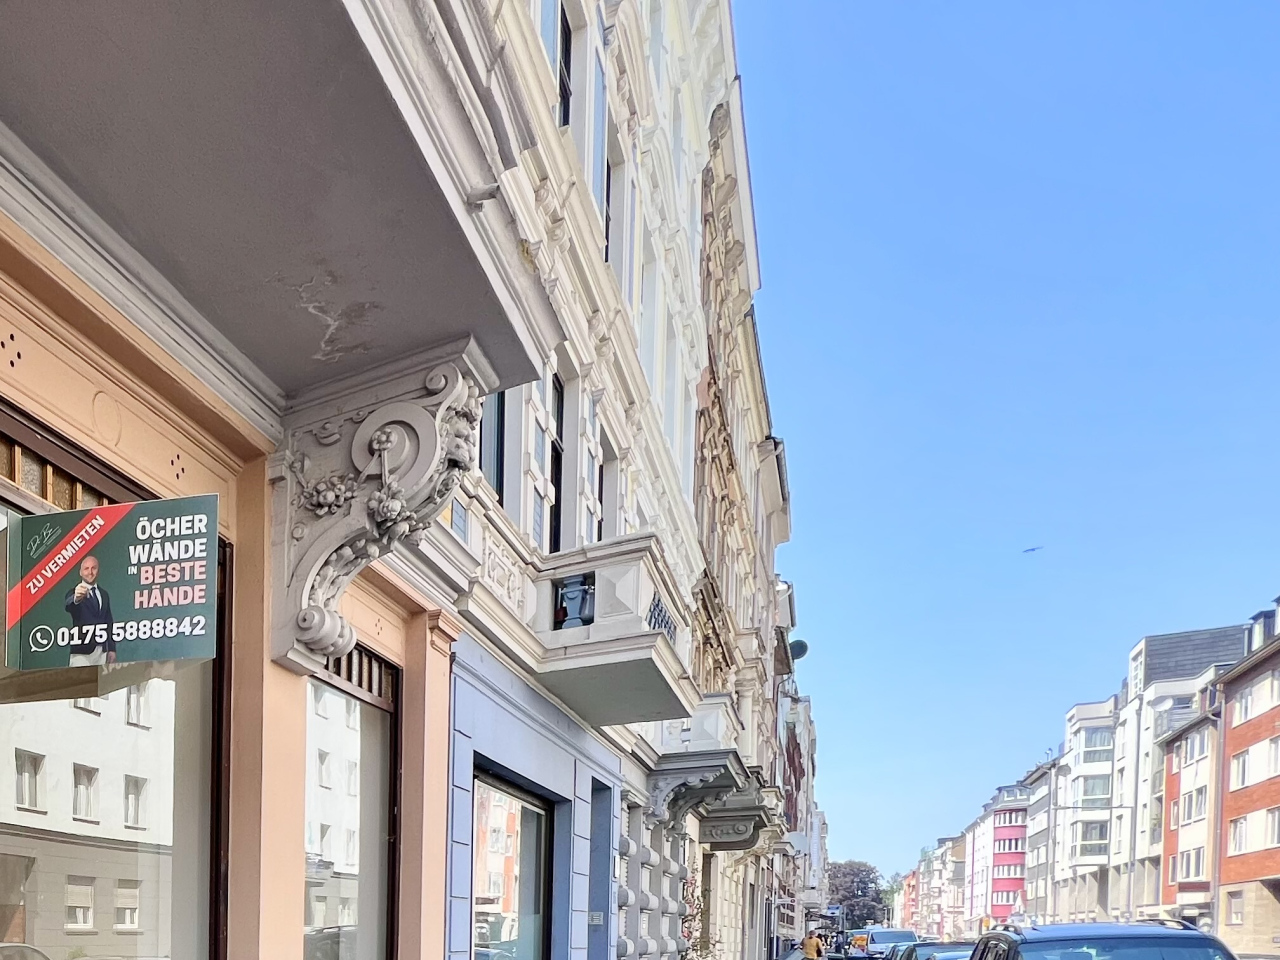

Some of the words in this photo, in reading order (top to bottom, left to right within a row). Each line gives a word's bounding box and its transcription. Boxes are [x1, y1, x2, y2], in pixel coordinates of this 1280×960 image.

[136, 514, 208, 540] ÖCHER
[25, 574, 45, 595] ZU
[43, 514, 106, 579] VERMIETEN
[128, 537, 208, 565] WÄNDE
[128, 566, 137, 575] IN
[140, 560, 207, 585] BESTE
[134, 584, 206, 610] HÄNDE
[56, 623, 108, 647] 0175
[112, 615, 206, 642] 5888842
